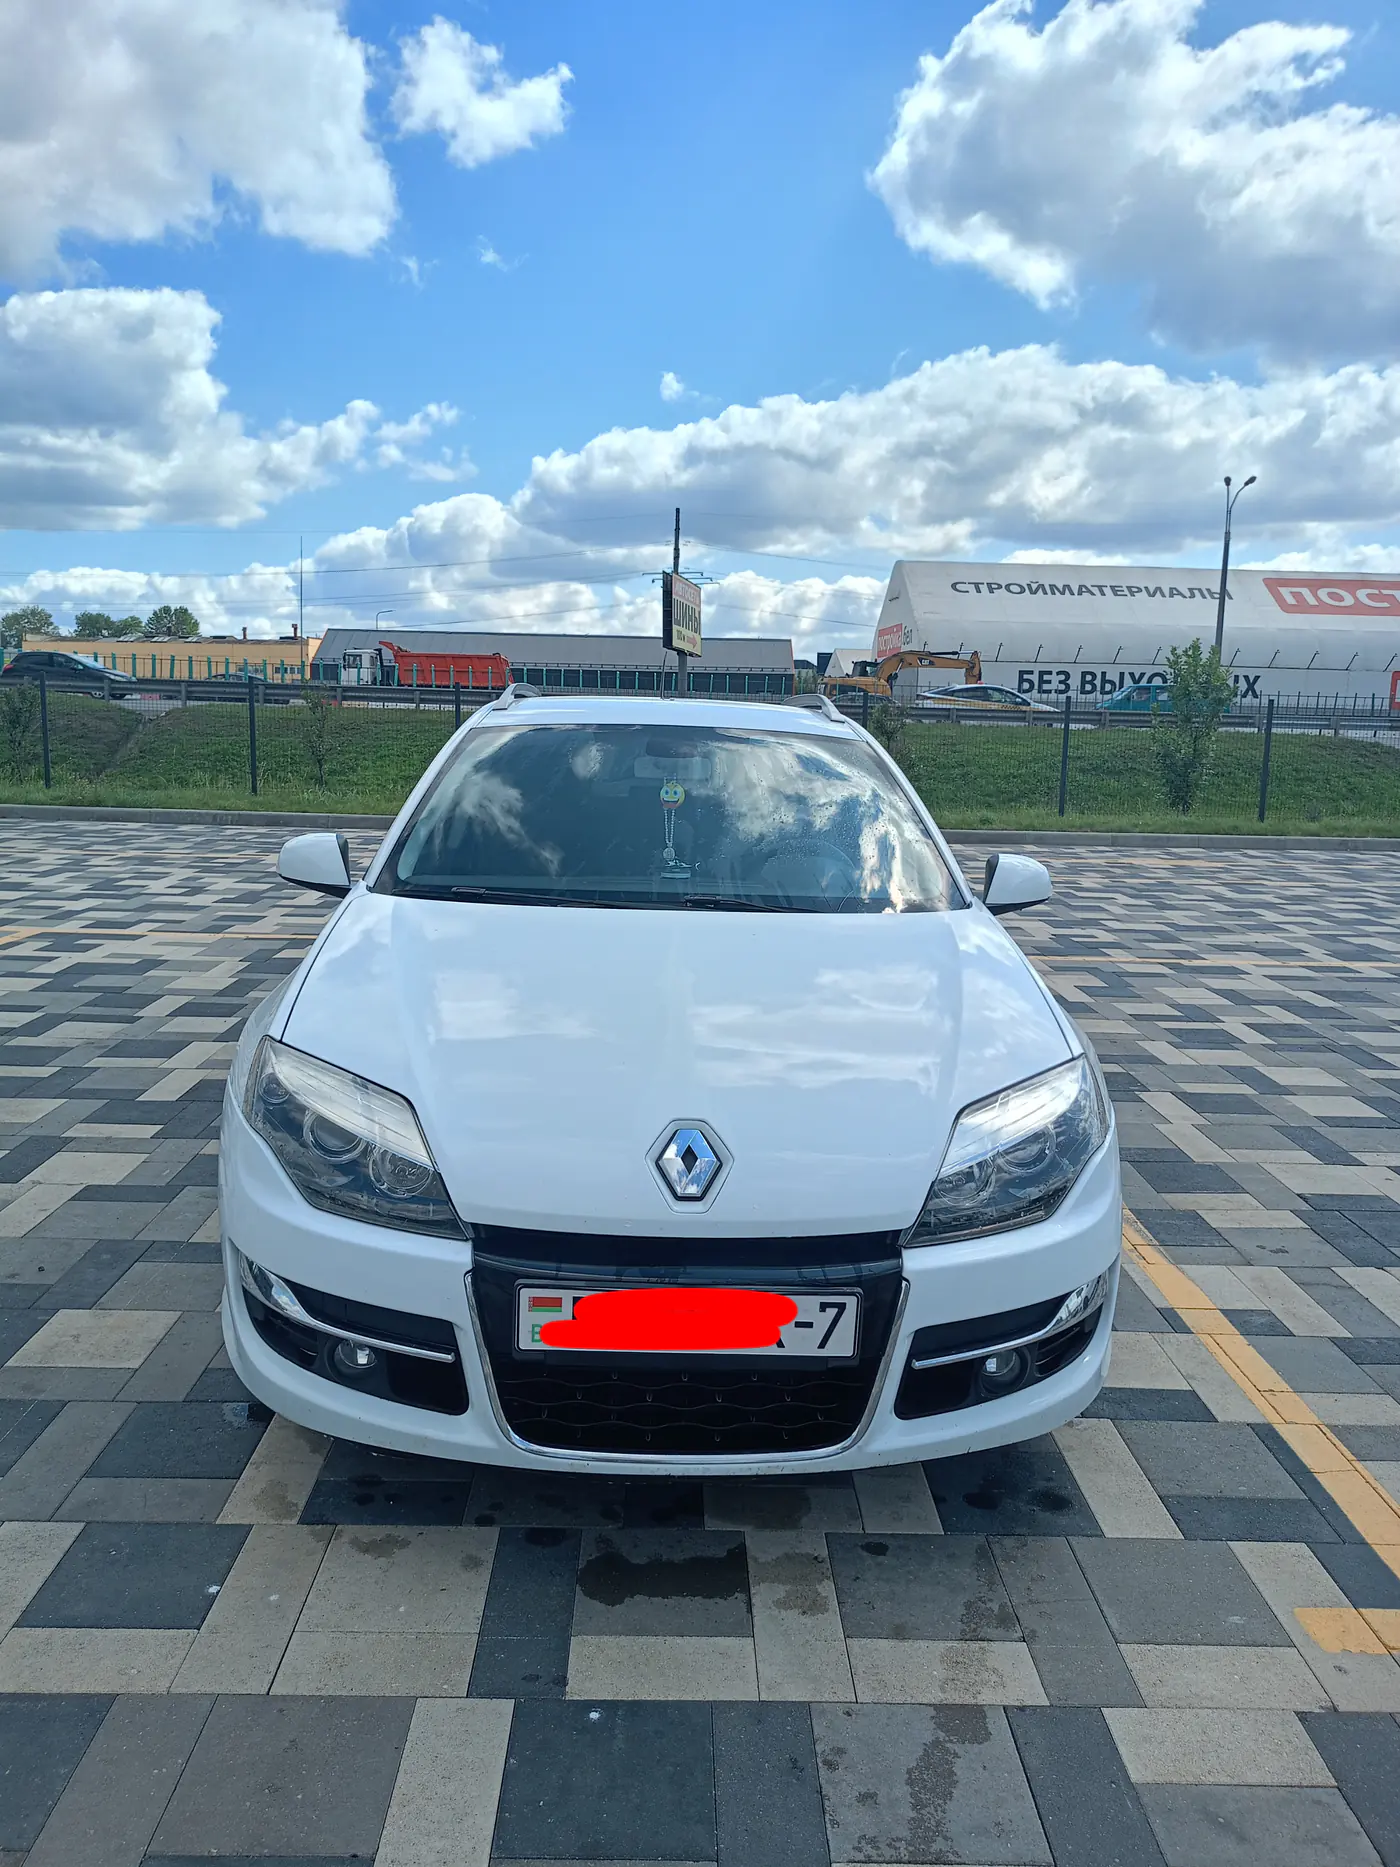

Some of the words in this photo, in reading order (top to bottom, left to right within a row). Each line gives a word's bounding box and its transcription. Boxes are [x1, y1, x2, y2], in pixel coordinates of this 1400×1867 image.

[950, 580, 1234, 601] СТРОЙМАТЕРИАЛЫ
[674, 598, 701, 635] ШИНЫ
[1017, 670, 1072, 696] БЕЗ
